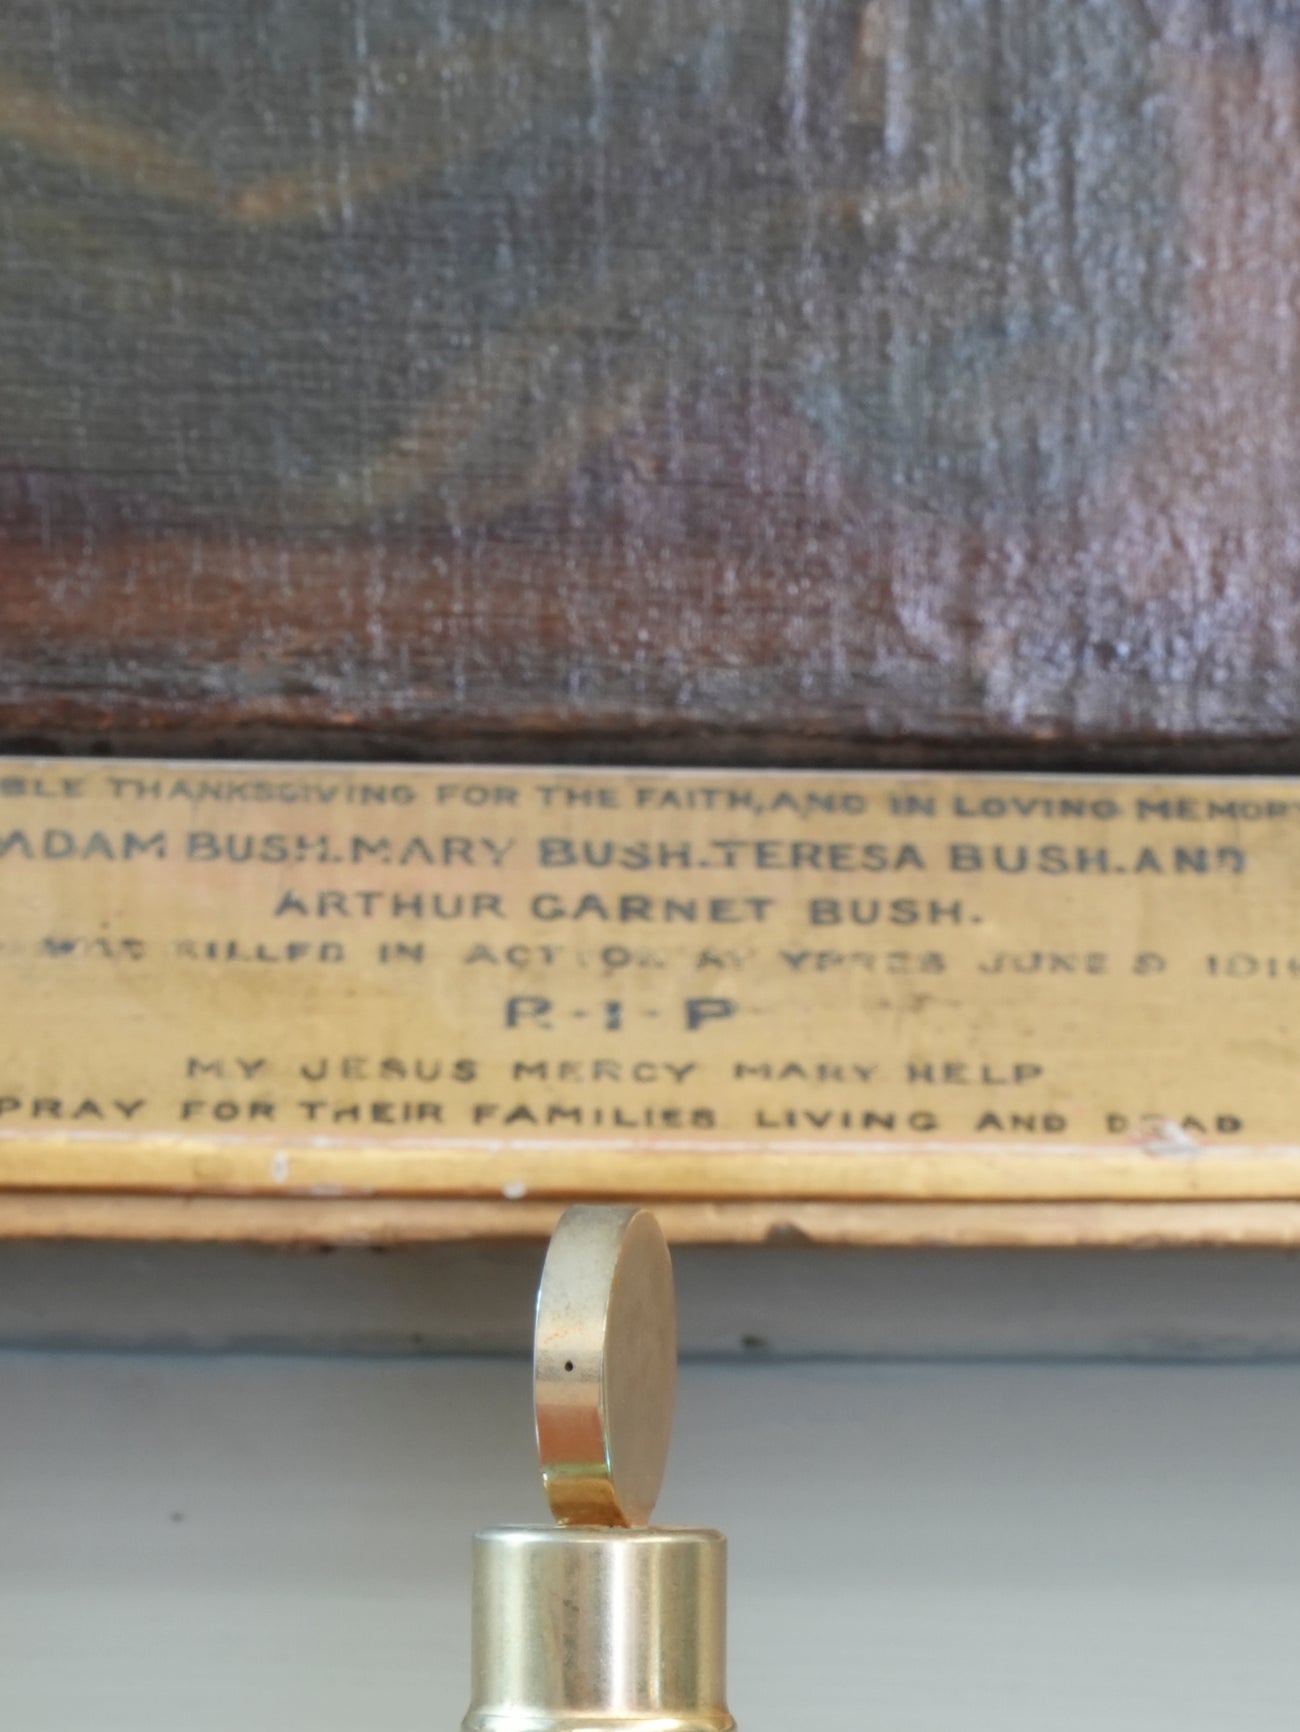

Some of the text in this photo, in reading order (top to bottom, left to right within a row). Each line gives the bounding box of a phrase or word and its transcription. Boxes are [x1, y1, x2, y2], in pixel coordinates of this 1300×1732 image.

[108, 776, 417, 807] THANKSGIVING
[435, 782, 521, 808] FOR
[535, 783, 622, 810] THE
[888, 792, 938, 818] IN
[951, 793, 1121, 821] LOVING
[0, 829, 168, 862] ADAM
[273, 889, 986, 926] ARTHUR GARNET BUSH.
[378, 941, 426, 965] IN
[463, 943, 667, 969] ACTO
[184, 1054, 1045, 1087] MY JESUS MERCY MARY HELP
[0, 1096, 147, 1122] PRAY
[179, 1099, 277, 1124] FOR
[298, 1100, 445, 1125] THEIR
[471, 1103, 716, 1130] FAMILIES
[754, 1107, 940, 1133] LIVING
[975, 1110, 1070, 1135] AND
